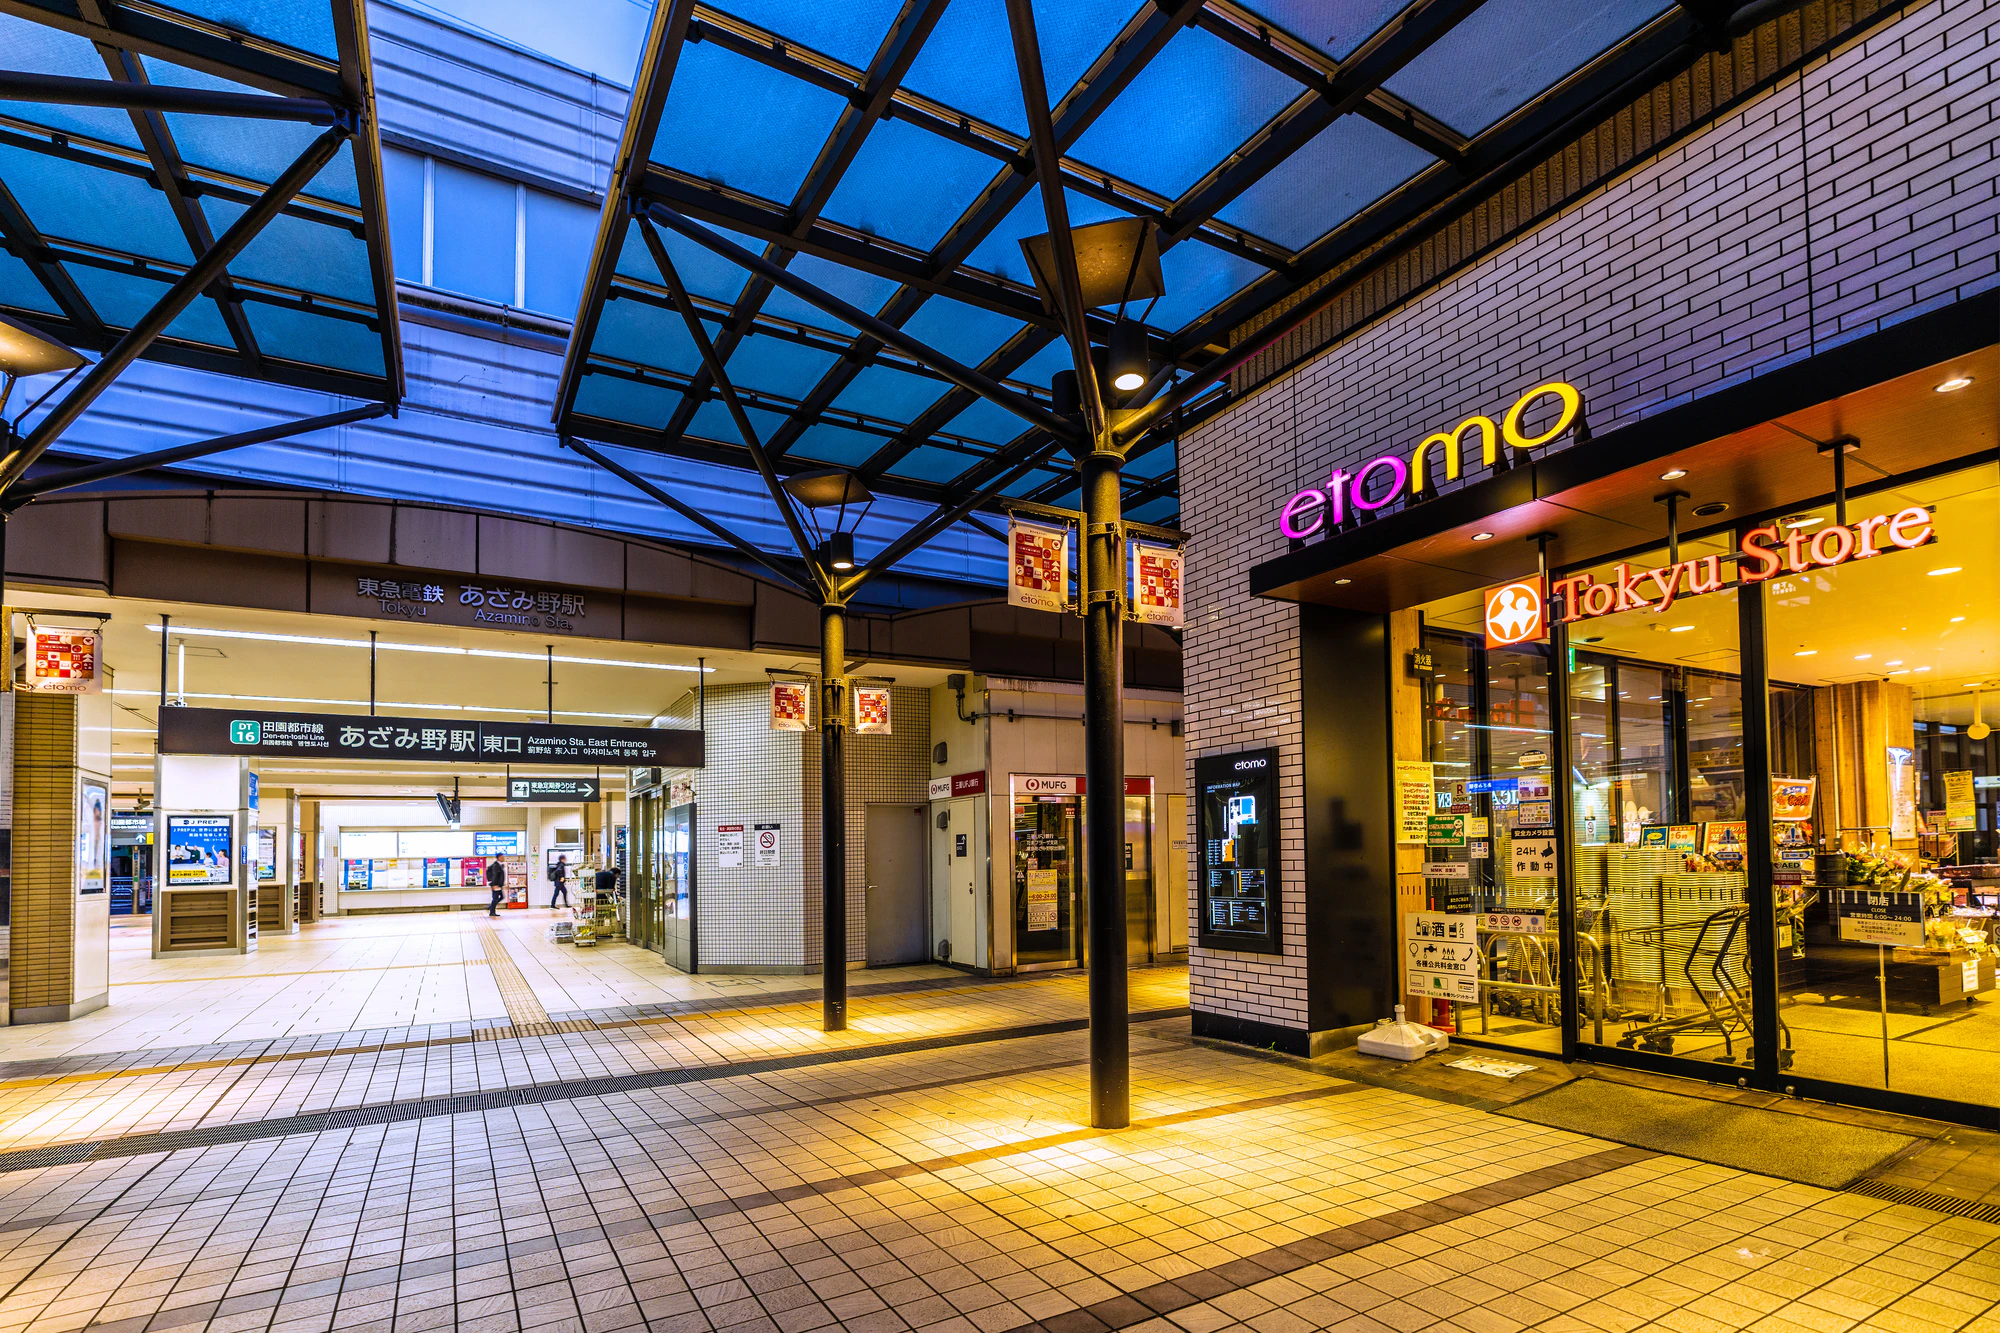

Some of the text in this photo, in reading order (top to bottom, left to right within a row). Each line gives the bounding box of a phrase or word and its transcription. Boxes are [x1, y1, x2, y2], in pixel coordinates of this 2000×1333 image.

[1279, 381, 1581, 539] etomo
[1553, 505, 1936, 623] Tokyu Store
[358, 577, 585, 617] 東急電鉄 あざみ野駅
[1020, 594, 1054, 607] etomo
[378, 599, 573, 630] Tokyu Azamino Sta.
[1146, 612, 1175, 623] etomo
[1414, 653, 1432, 666] 消火器
[43, 684, 87, 692] etomo
[238, 723, 253, 731] DT
[262, 721, 325, 734] 田園都市線
[236, 732, 256, 742] 16
[262, 732, 309, 741] Den-en-toshi
[339, 725, 522, 753] あざみ野駅 東口
[527, 736, 648, 748] Azamino Sta. East Entrance
[1234, 758, 1267, 770] etomo
[530, 781, 577, 790] 東急定期券うりば
[937, 783, 950, 792] MUFG
[1041, 780, 1067, 790] MUFG
[1516, 847, 1536, 856] 24H
[1869, 896, 1890, 906] 閉店
[1432, 922, 1446, 938] 酒
[1416, 960, 1466, 970] 各種公共料金窓口
